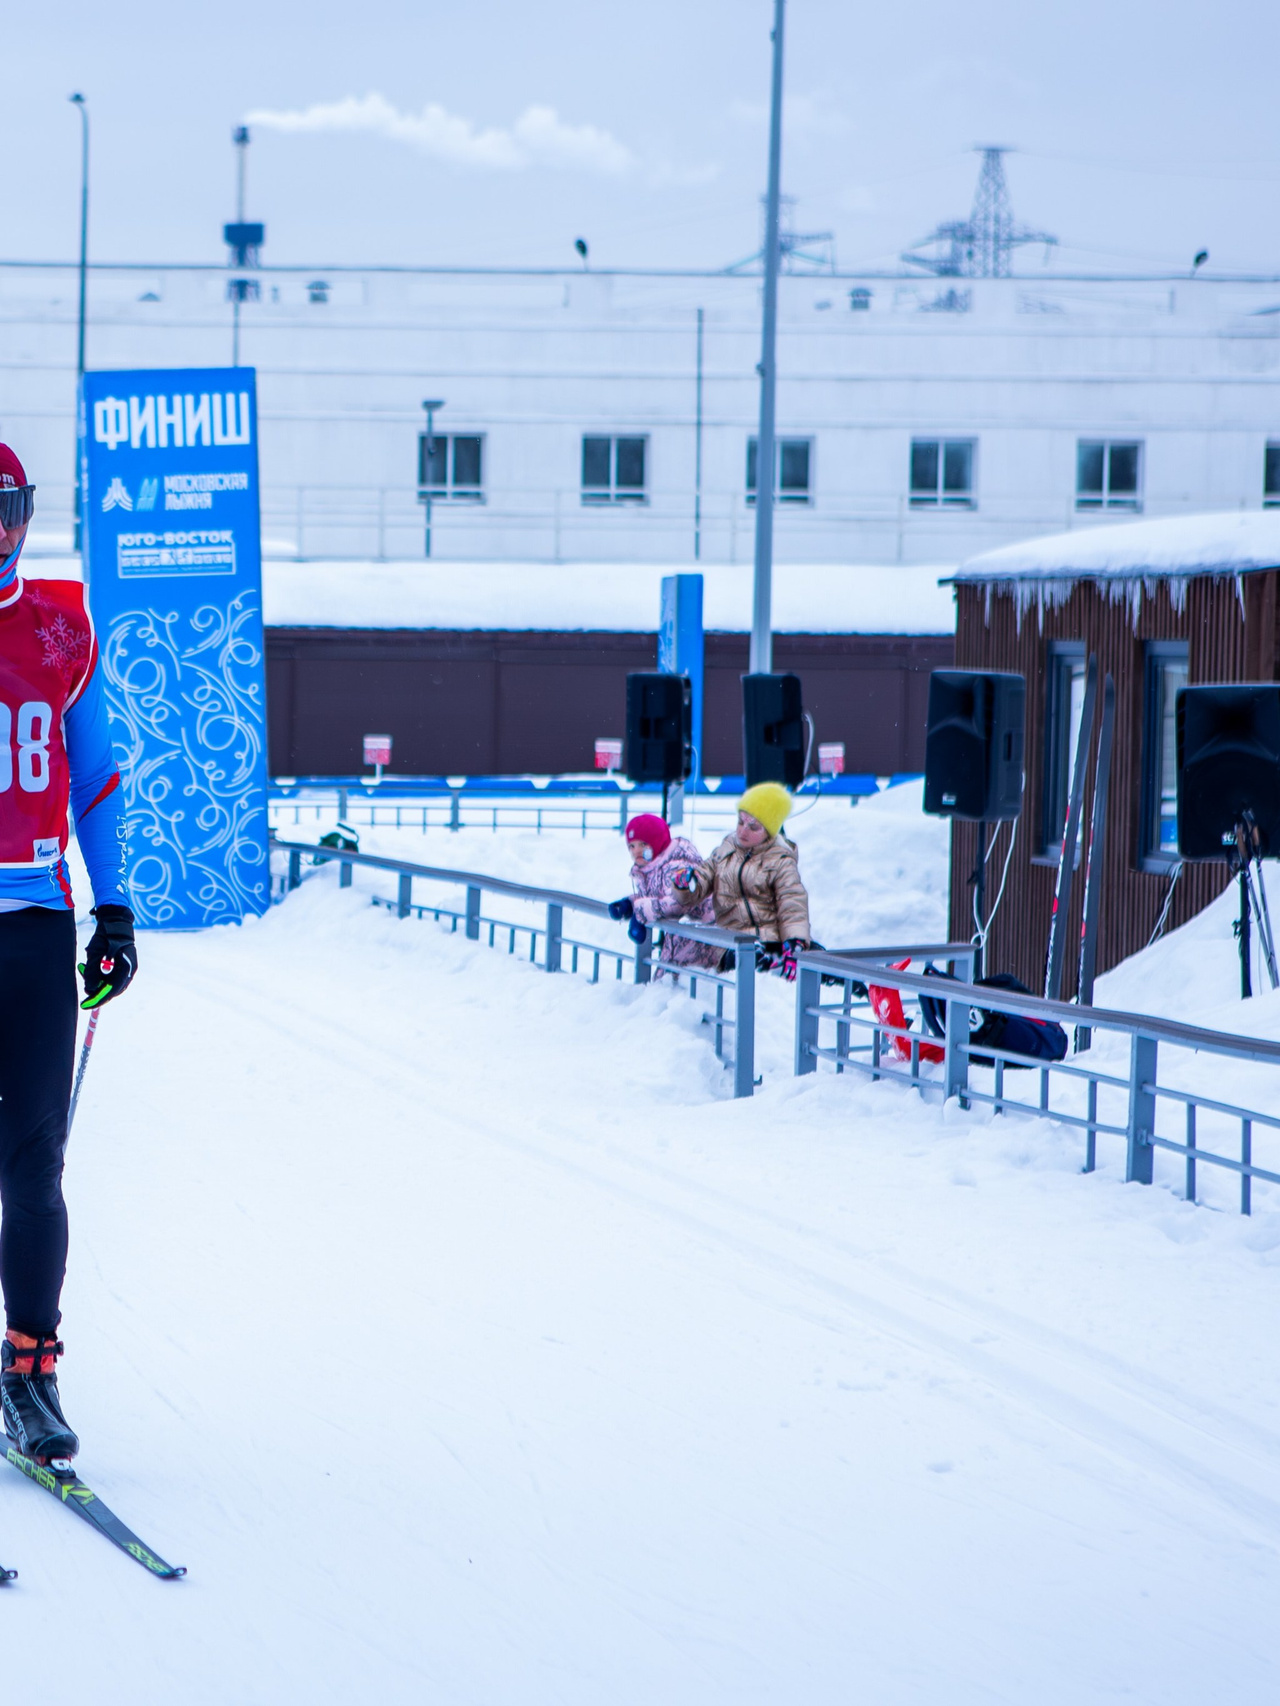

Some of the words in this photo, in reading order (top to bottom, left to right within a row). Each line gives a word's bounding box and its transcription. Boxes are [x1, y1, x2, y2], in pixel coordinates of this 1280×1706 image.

[94, 391, 250, 450] ФИНИШ
[164, 473, 248, 493] МОСКОВСКАЯ
[118, 530, 233, 547] ЮГО-ВОСТОК
[7, 1447, 56, 1493] FISCHER
